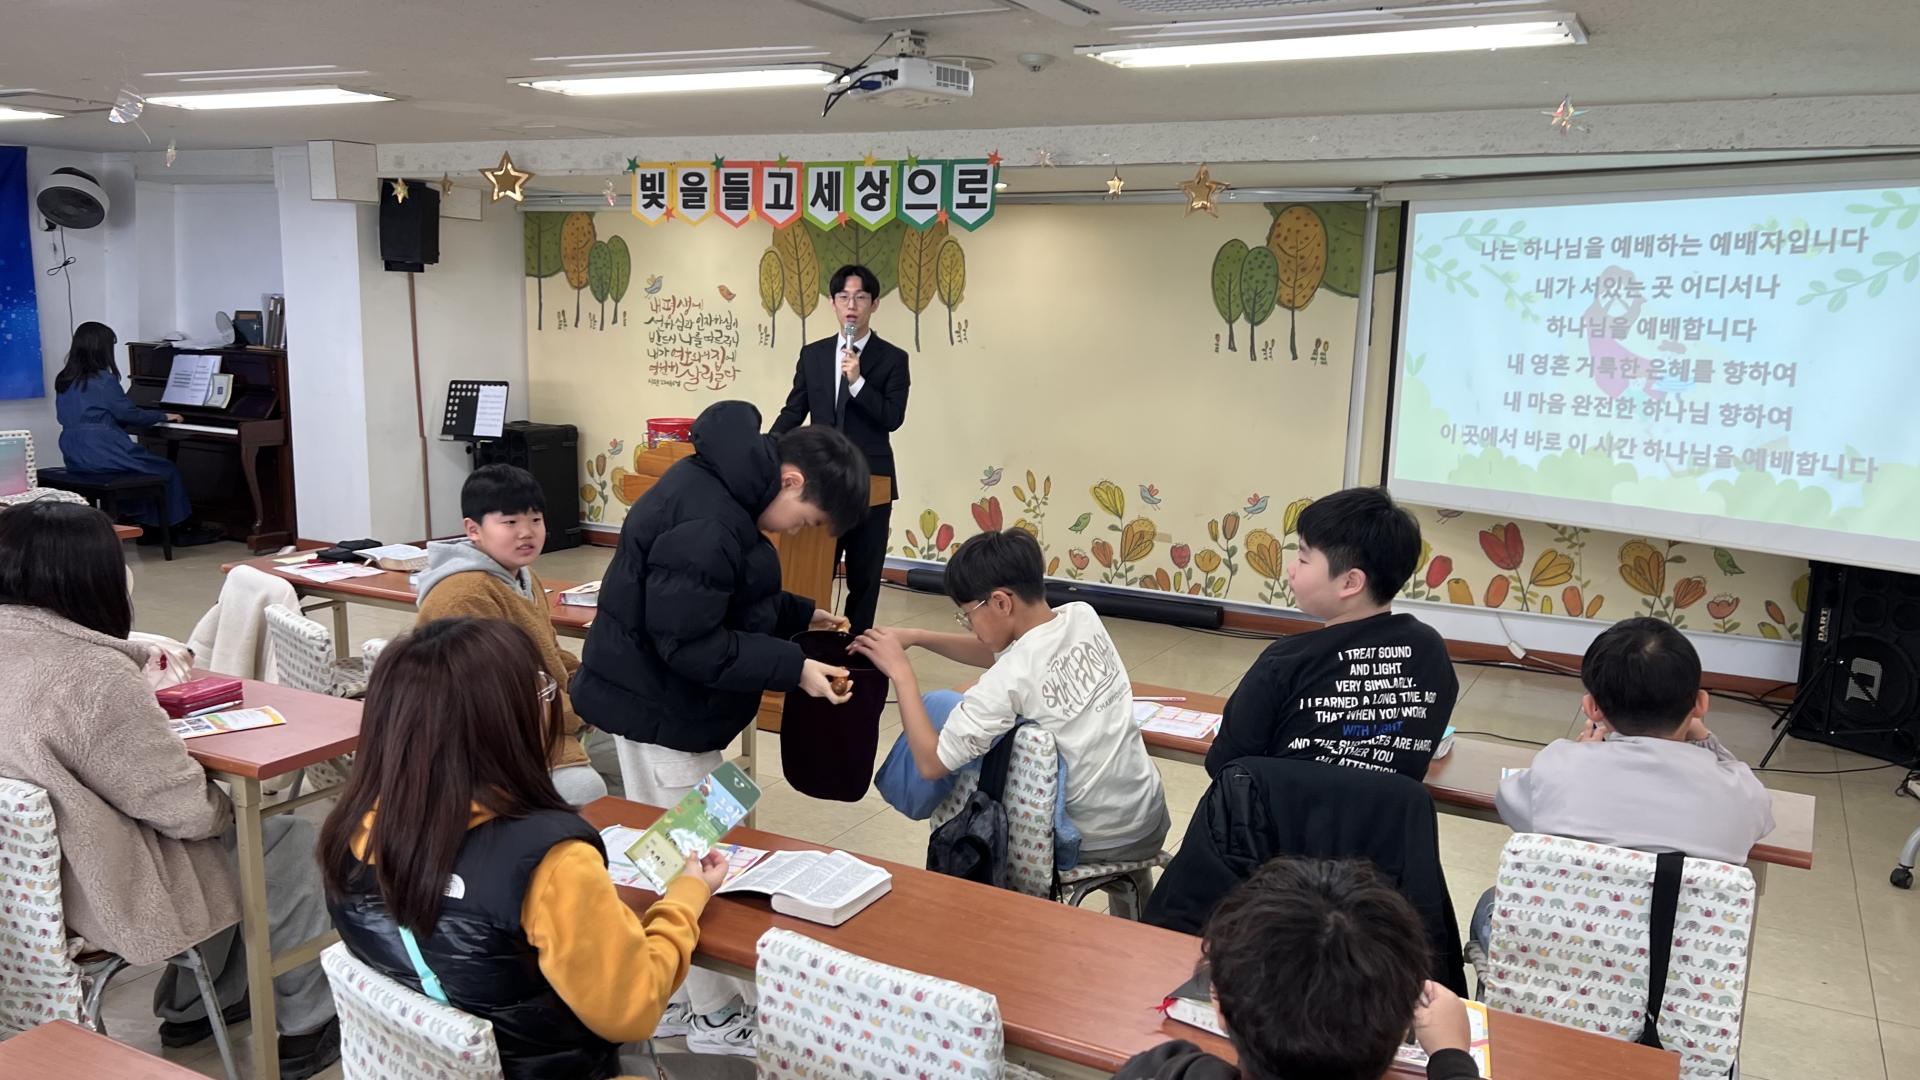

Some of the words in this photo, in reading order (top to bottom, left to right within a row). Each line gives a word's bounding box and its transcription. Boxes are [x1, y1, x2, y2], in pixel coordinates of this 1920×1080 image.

[1480, 240, 1517, 261] 나는
[1523, 236, 1605, 260] 하나님을
[1611, 234, 1703, 258] 예배하는
[1709, 227, 1870, 257] 예배자입니다
[1535, 276, 1576, 299] 내가
[1580, 275, 1646, 299] 서있는
[1651, 276, 1675, 299] 곳
[1681, 273, 1781, 300] 어디서나
[1546, 315, 1632, 340] 하나님을
[1636, 316, 1757, 344] 예배합니다
[649, 330, 676, 347] 반드시
[679, 331, 703, 349] 나를
[646, 347, 669, 360] 내가
[649, 360, 679, 376] 영원히
[1507, 353, 1525, 375] 내
[1531, 353, 1571, 377] 영혼
[1575, 356, 1641, 379] 거룩한
[1646, 357, 1716, 384] 은혜를
[1723, 360, 1798, 388] 향하여
[1503, 391, 1522, 412] 내
[1528, 392, 1567, 415] 마음
[1571, 394, 1637, 419] 완전한
[1642, 398, 1710, 425] 하나님
[1719, 402, 1794, 432] 향하여
[1440, 423, 1457, 445] 이
[1462, 424, 1518, 449] 곳에서
[1524, 429, 1563, 452] 바로
[1568, 433, 1588, 455] 이
[1593, 435, 1638, 460] 시간
[1642, 438, 1736, 469] 하나님을
[1742, 447, 1879, 484] 예배합니다
[1817, 608, 1829, 642] DART
[1338, 651, 1343, 661] I
[1345, 647, 1376, 660] TREAT
[1378, 646, 1412, 659] SOUND
[1350, 664, 1370, 676] AND
[1373, 663, 1402, 675] LIGHT
[1335, 680, 1361, 692] VERY
[1364, 677, 1416, 692] SIMILARLY.
[1363, 696, 1370, 706] A
[1372, 693, 1397, 705] LONG
[1424, 691, 1437, 704] AGO
[1315, 711, 1345, 723] THAT
[1346, 709, 1376, 721] WHEN
[1379, 708, 1400, 720] YOU
[1401, 706, 1428, 719] WORK
[1343, 724, 1370, 736] WITH
[1373, 721, 1404, 735] LIGHT
[1288, 738, 1310, 749] AND
[1314, 739, 1335, 750] THE
[1392, 737, 1413, 750] ARE
[1372, 748, 1394, 763] YOU
[736, 1028, 752, 1040] N
